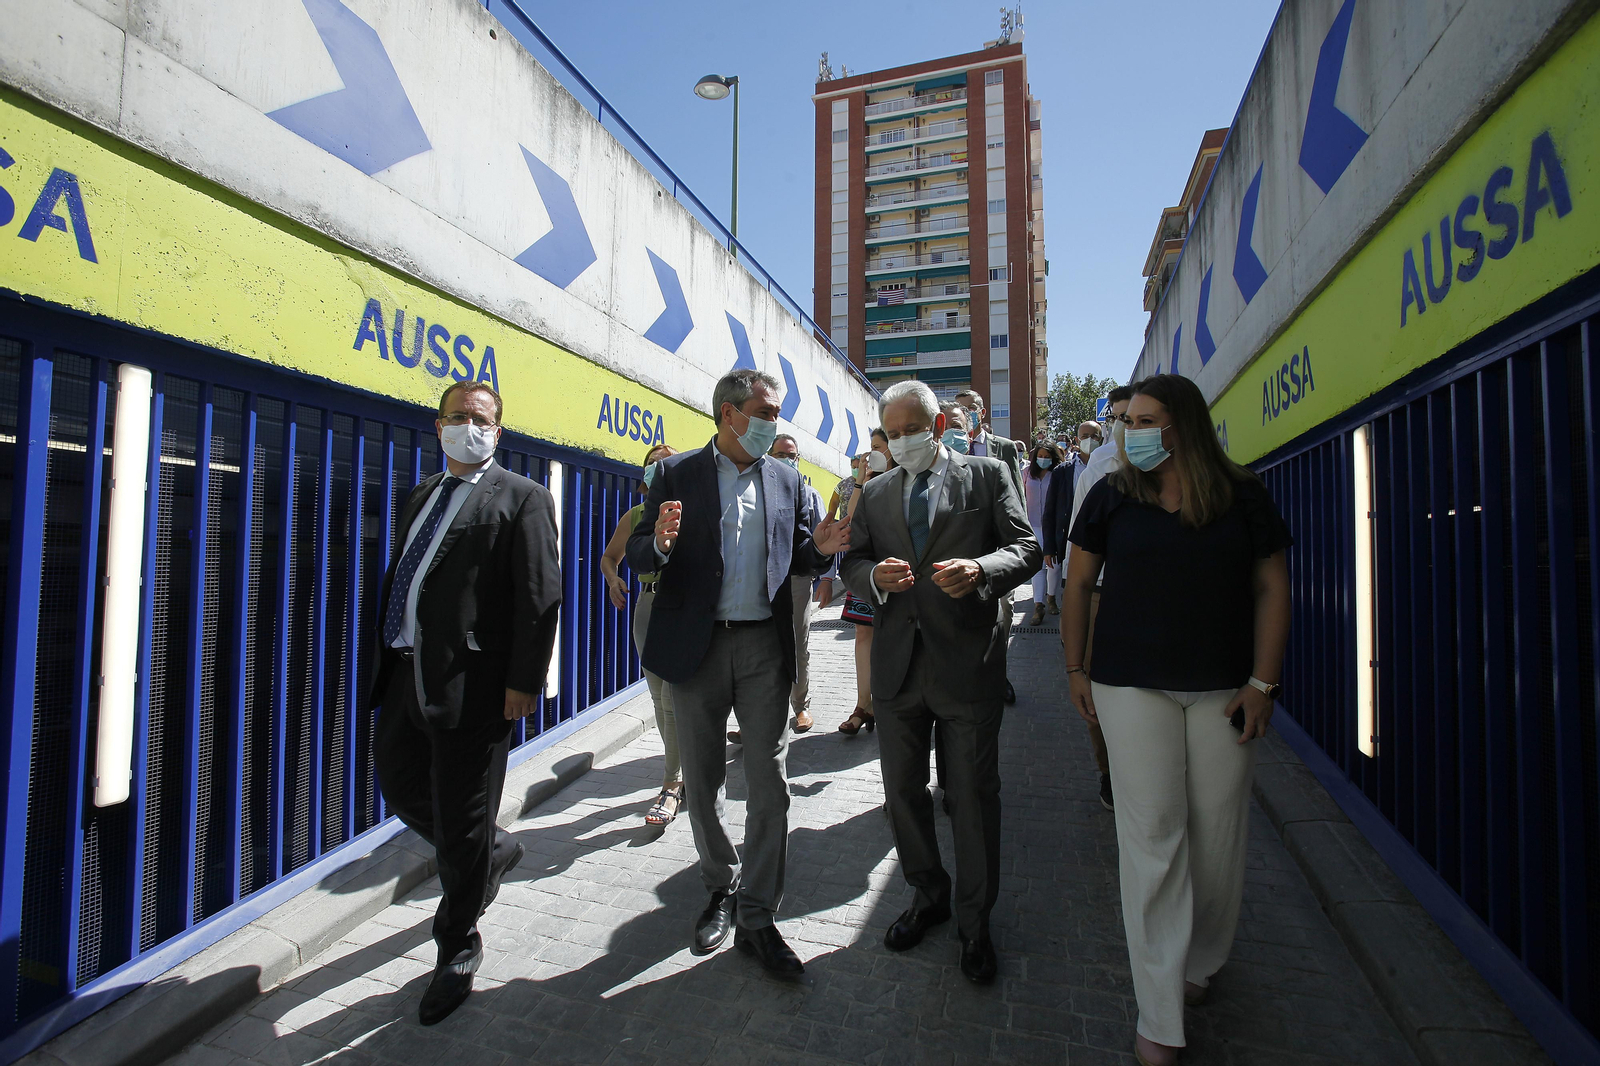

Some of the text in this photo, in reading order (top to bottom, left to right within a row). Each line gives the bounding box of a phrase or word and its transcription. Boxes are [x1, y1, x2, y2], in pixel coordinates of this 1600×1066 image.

[1400, 131, 1573, 328] AUSSA
[353, 298, 499, 395] AUSSA
[1262, 345, 1315, 426] AUSSA
[597, 393, 665, 447] AUSSA
